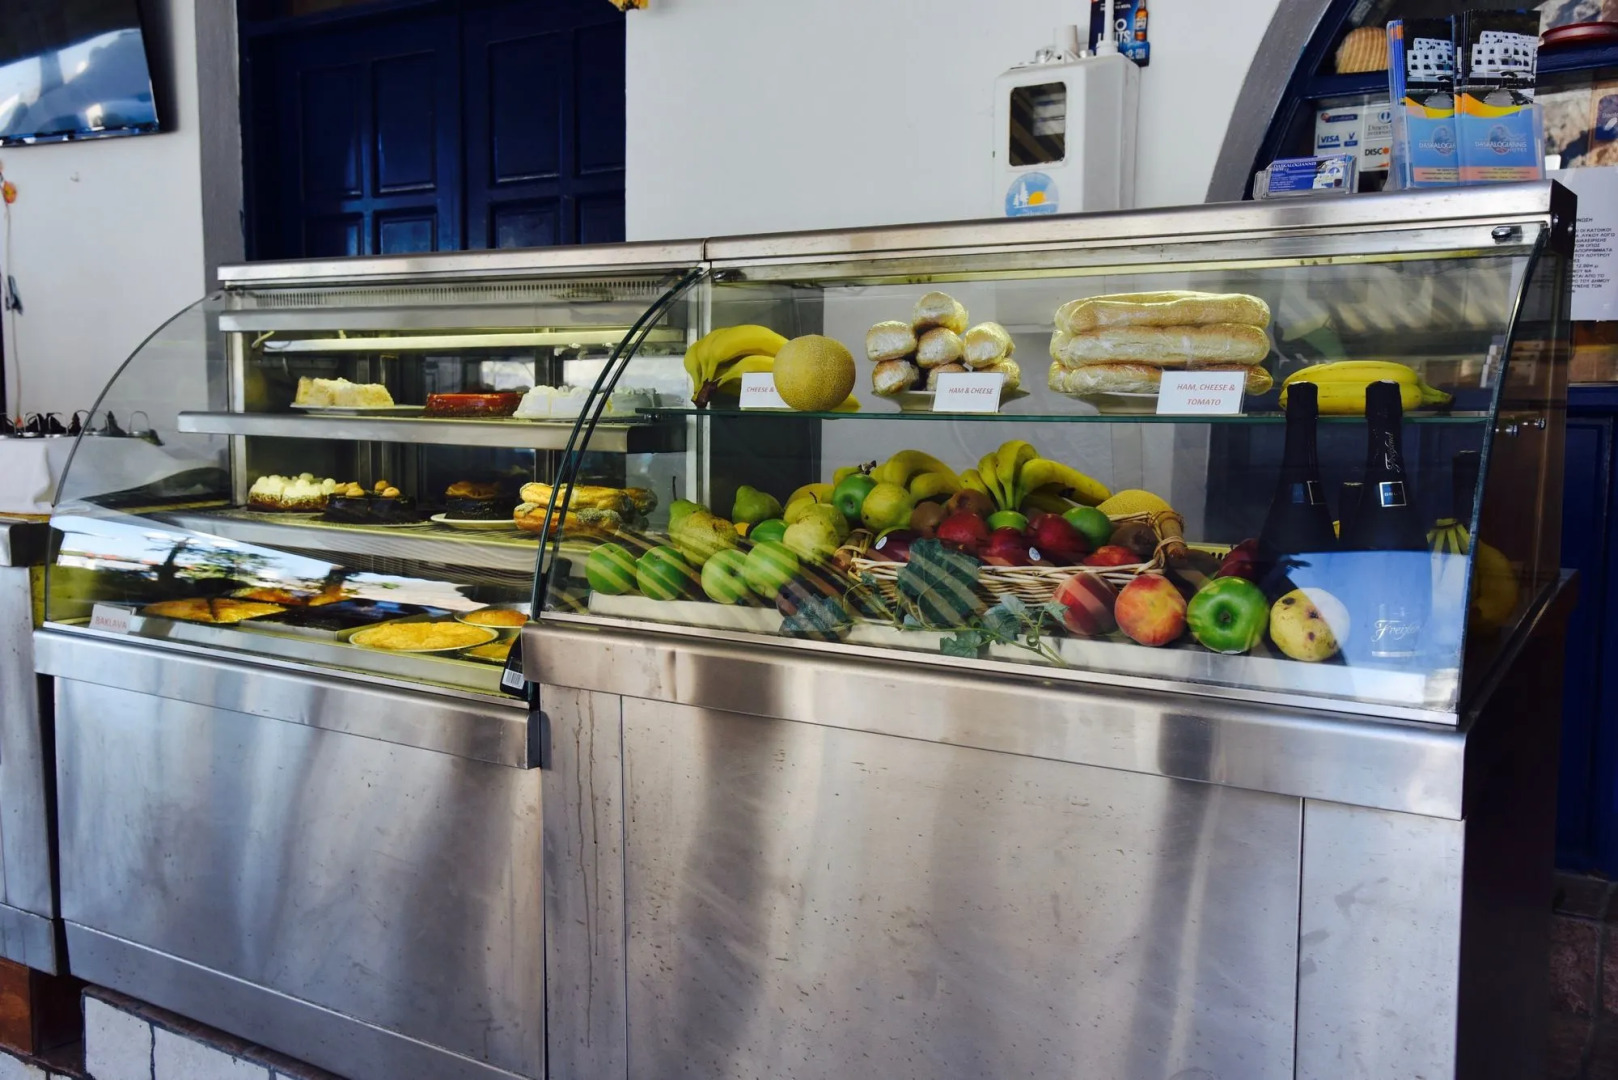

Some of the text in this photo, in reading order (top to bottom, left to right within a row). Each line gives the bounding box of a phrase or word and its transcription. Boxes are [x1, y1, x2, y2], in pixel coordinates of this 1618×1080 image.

[1321, 135, 1340, 143] VISA
[970, 387, 994, 395] CHEESE
[1176, 383, 1197, 391] HAM,
[1199, 383, 1229, 391] CHEESE
[1187, 398, 1222, 406] TOMATO
